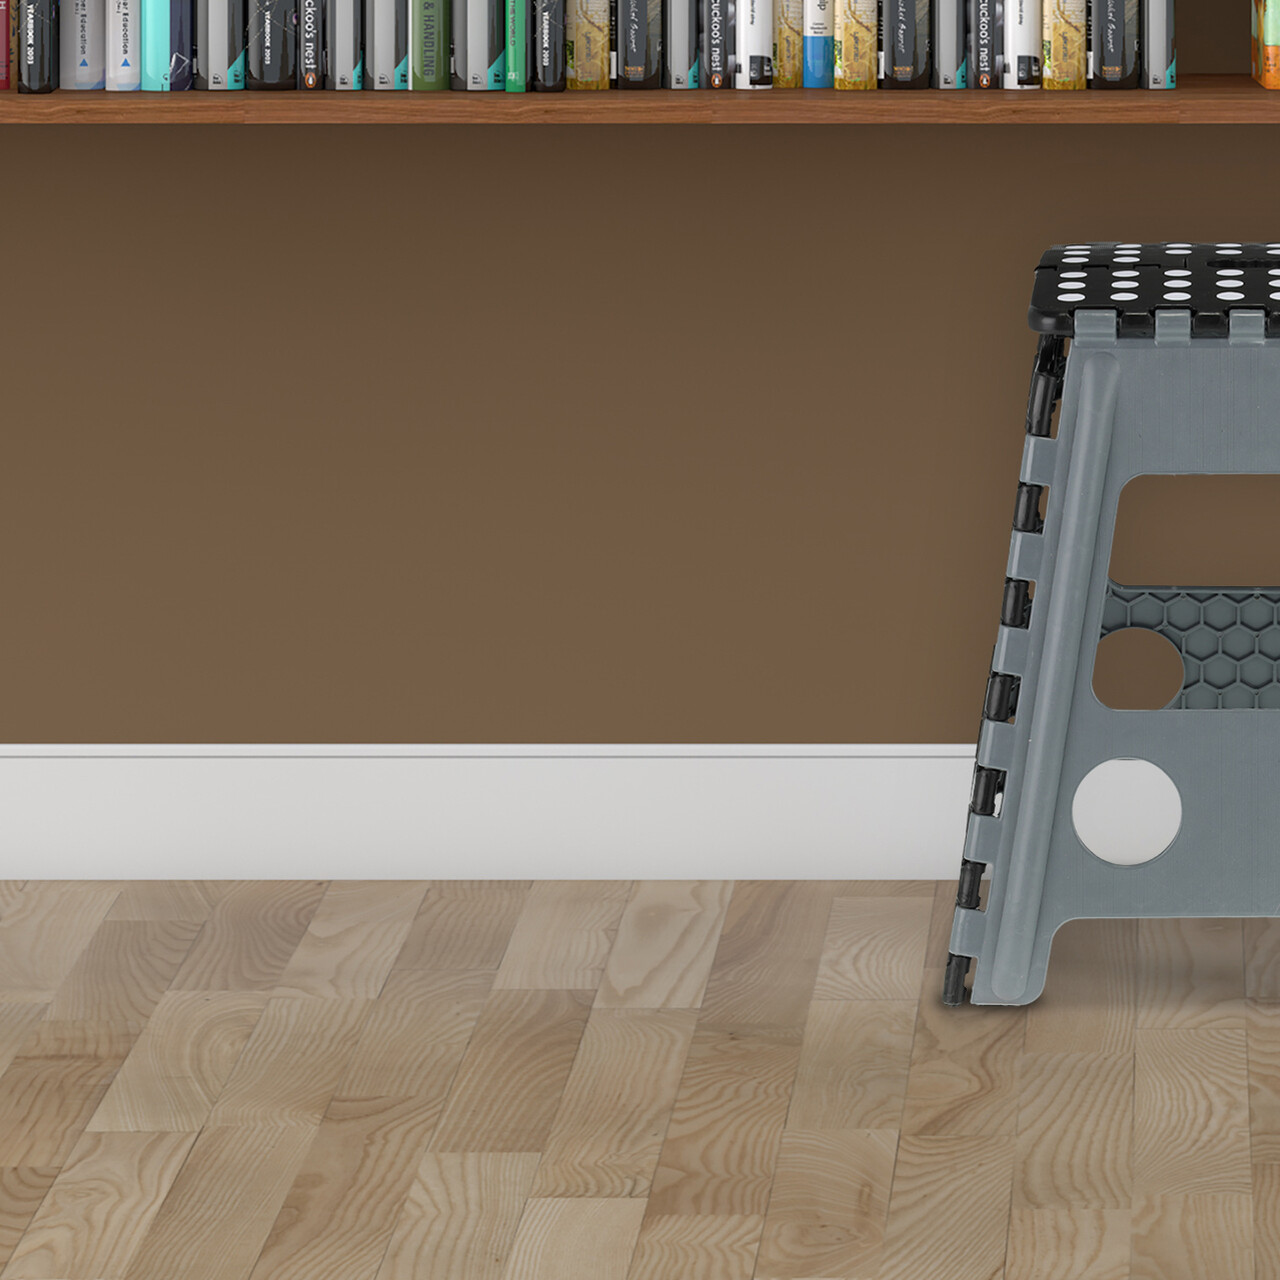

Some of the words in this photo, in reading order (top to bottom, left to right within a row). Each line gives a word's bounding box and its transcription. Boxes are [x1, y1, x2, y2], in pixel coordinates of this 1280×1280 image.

[423, 2, 434, 10] &
[305, 43, 315, 69] nest
[423, 14, 434, 76] HANDLING
